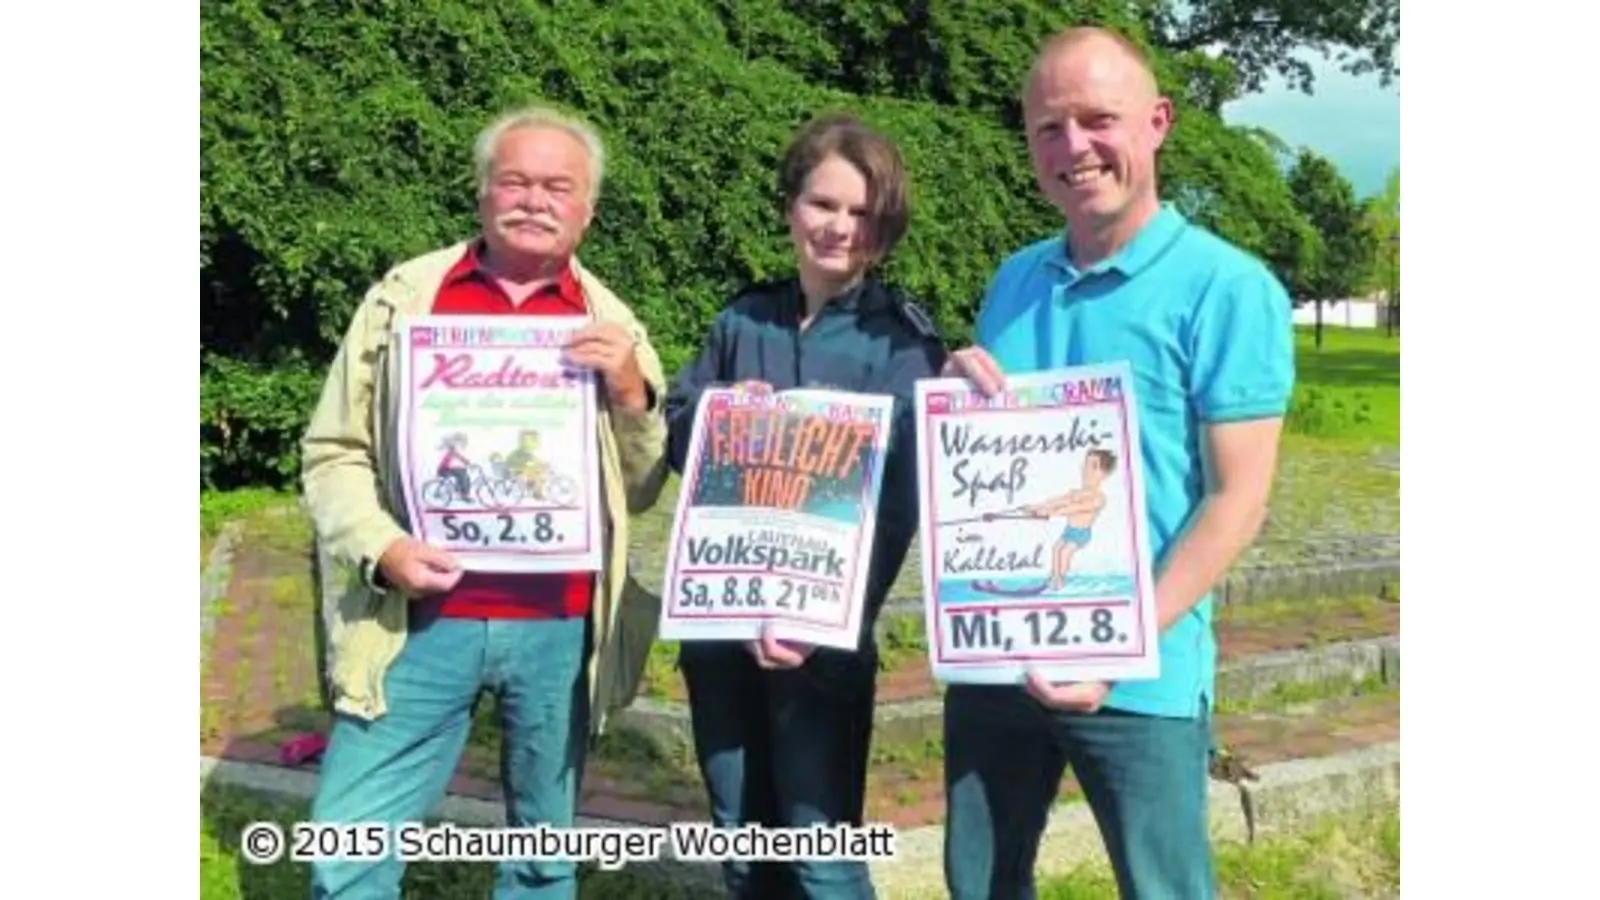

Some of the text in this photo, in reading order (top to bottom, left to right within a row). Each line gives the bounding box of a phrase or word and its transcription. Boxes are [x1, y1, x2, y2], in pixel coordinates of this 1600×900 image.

[707, 408, 876, 478] FREILICHT
[940, 417, 1113, 457] Wasserski-
[743, 470, 812, 512] KINO
[952, 457, 1029, 507] Spaß
[442, 515, 489, 545] So,
[688, 535, 846, 578] Volkspark
[943, 545, 1044, 574] Kalletal
[680, 576, 714, 611] Sa,
[722, 576, 766, 607] 8.8.
[951, 607, 1013, 652] Mi,
